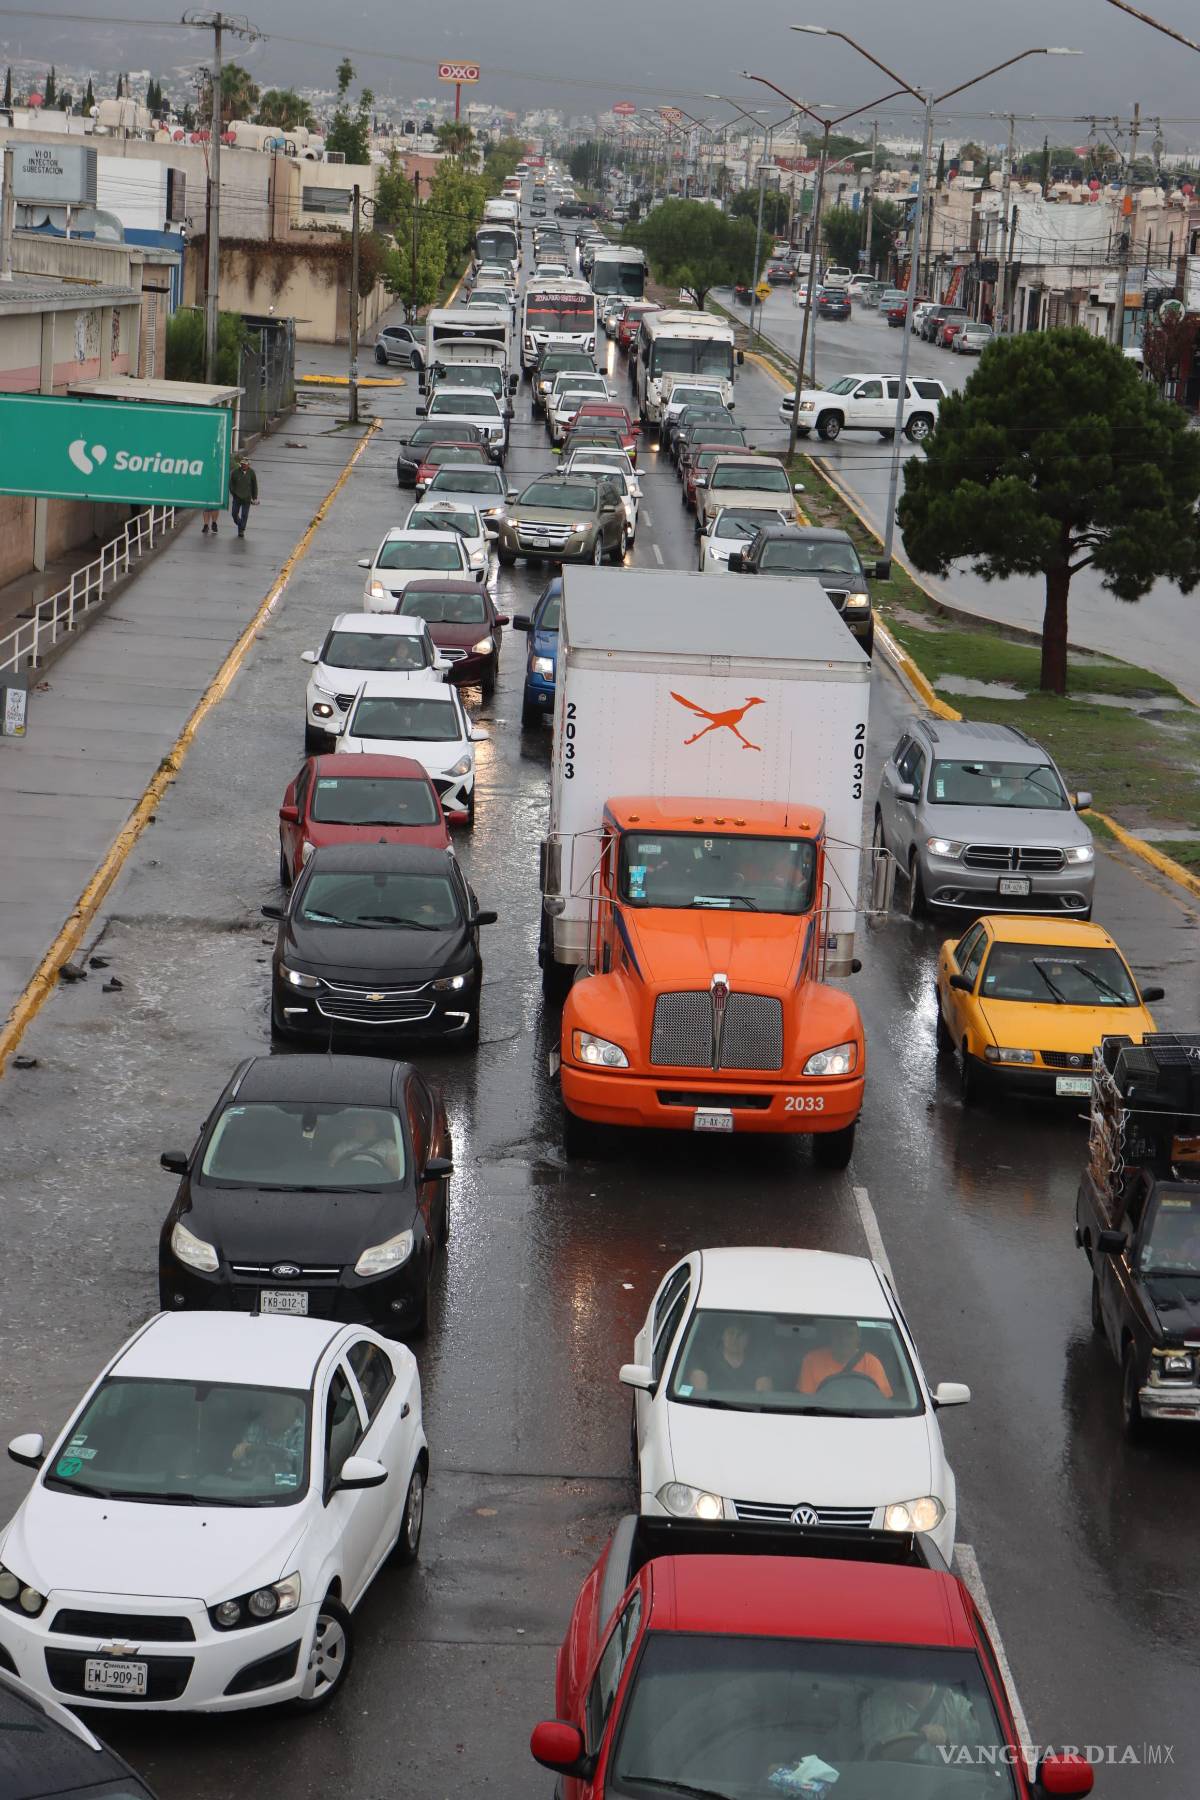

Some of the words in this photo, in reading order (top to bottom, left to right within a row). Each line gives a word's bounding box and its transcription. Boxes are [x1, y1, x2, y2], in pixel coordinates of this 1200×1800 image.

[441, 66, 478, 78] OXXO
[114, 451, 204, 476] Soriana
[565, 703, 577, 779] 2033
[852, 723, 866, 800] 2033
[784, 1096, 824, 1111] 2033
[263, 1297, 306, 1309] FKB-012-C
[88, 1668, 144, 1686] EWJ-909-D
